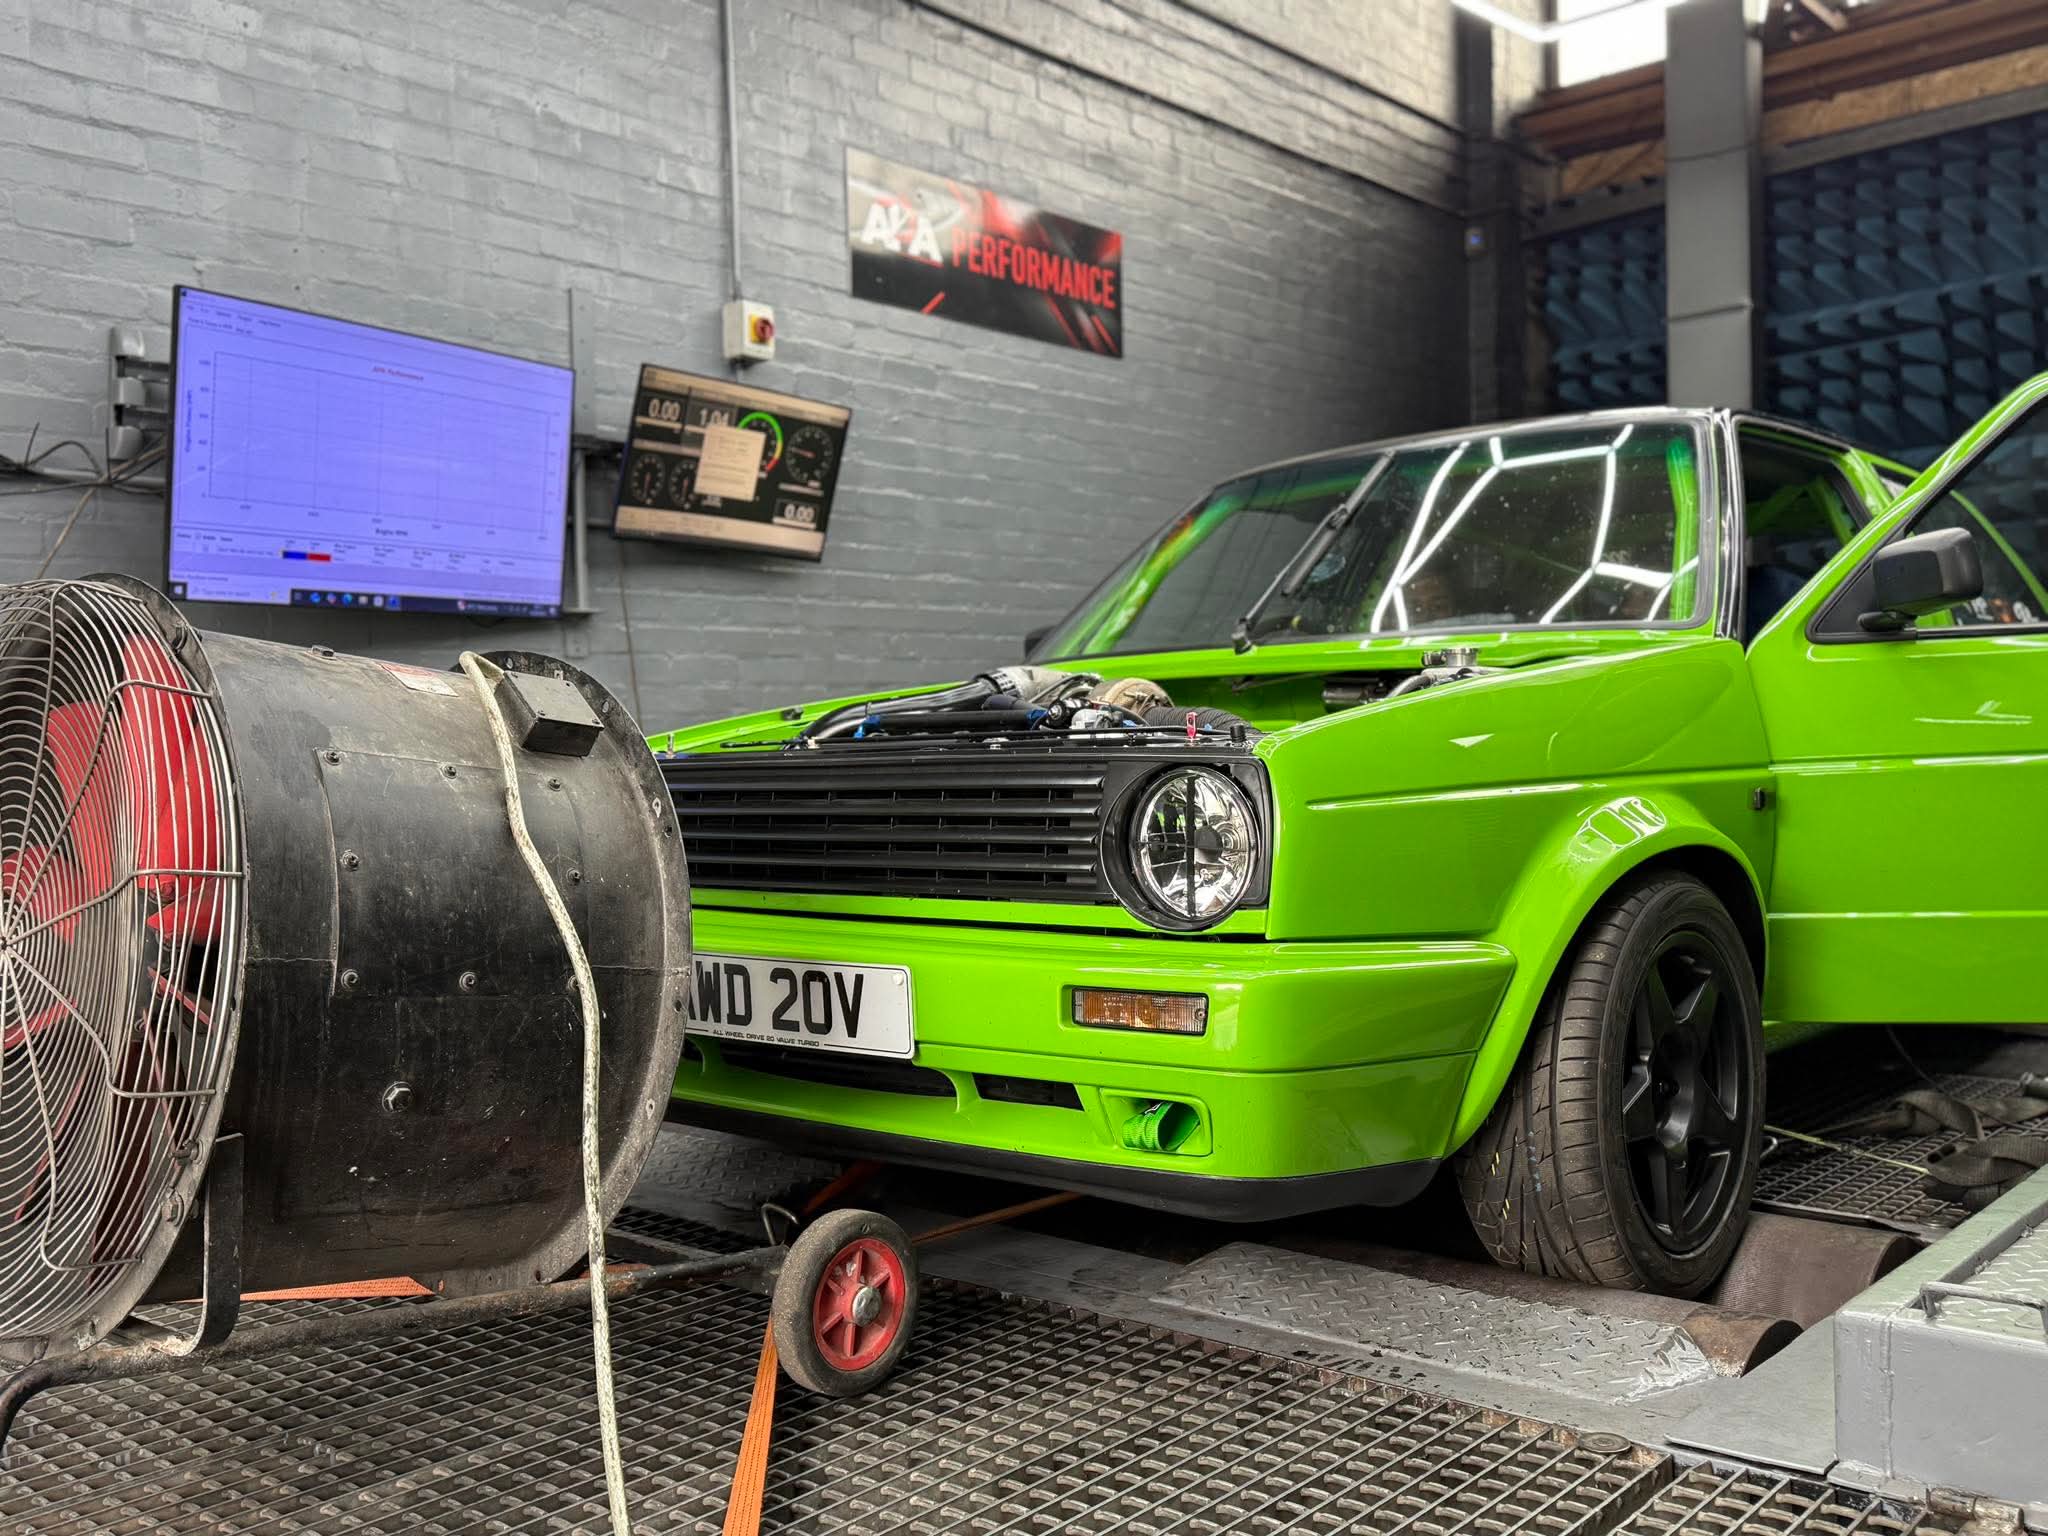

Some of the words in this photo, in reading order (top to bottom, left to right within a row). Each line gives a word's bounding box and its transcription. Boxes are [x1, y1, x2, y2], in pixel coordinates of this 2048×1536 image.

[951, 226, 1117, 311] PERFORMANCE
[769, 967, 864, 1039] 20V
[797, 1039, 820, 1047] TURBO
